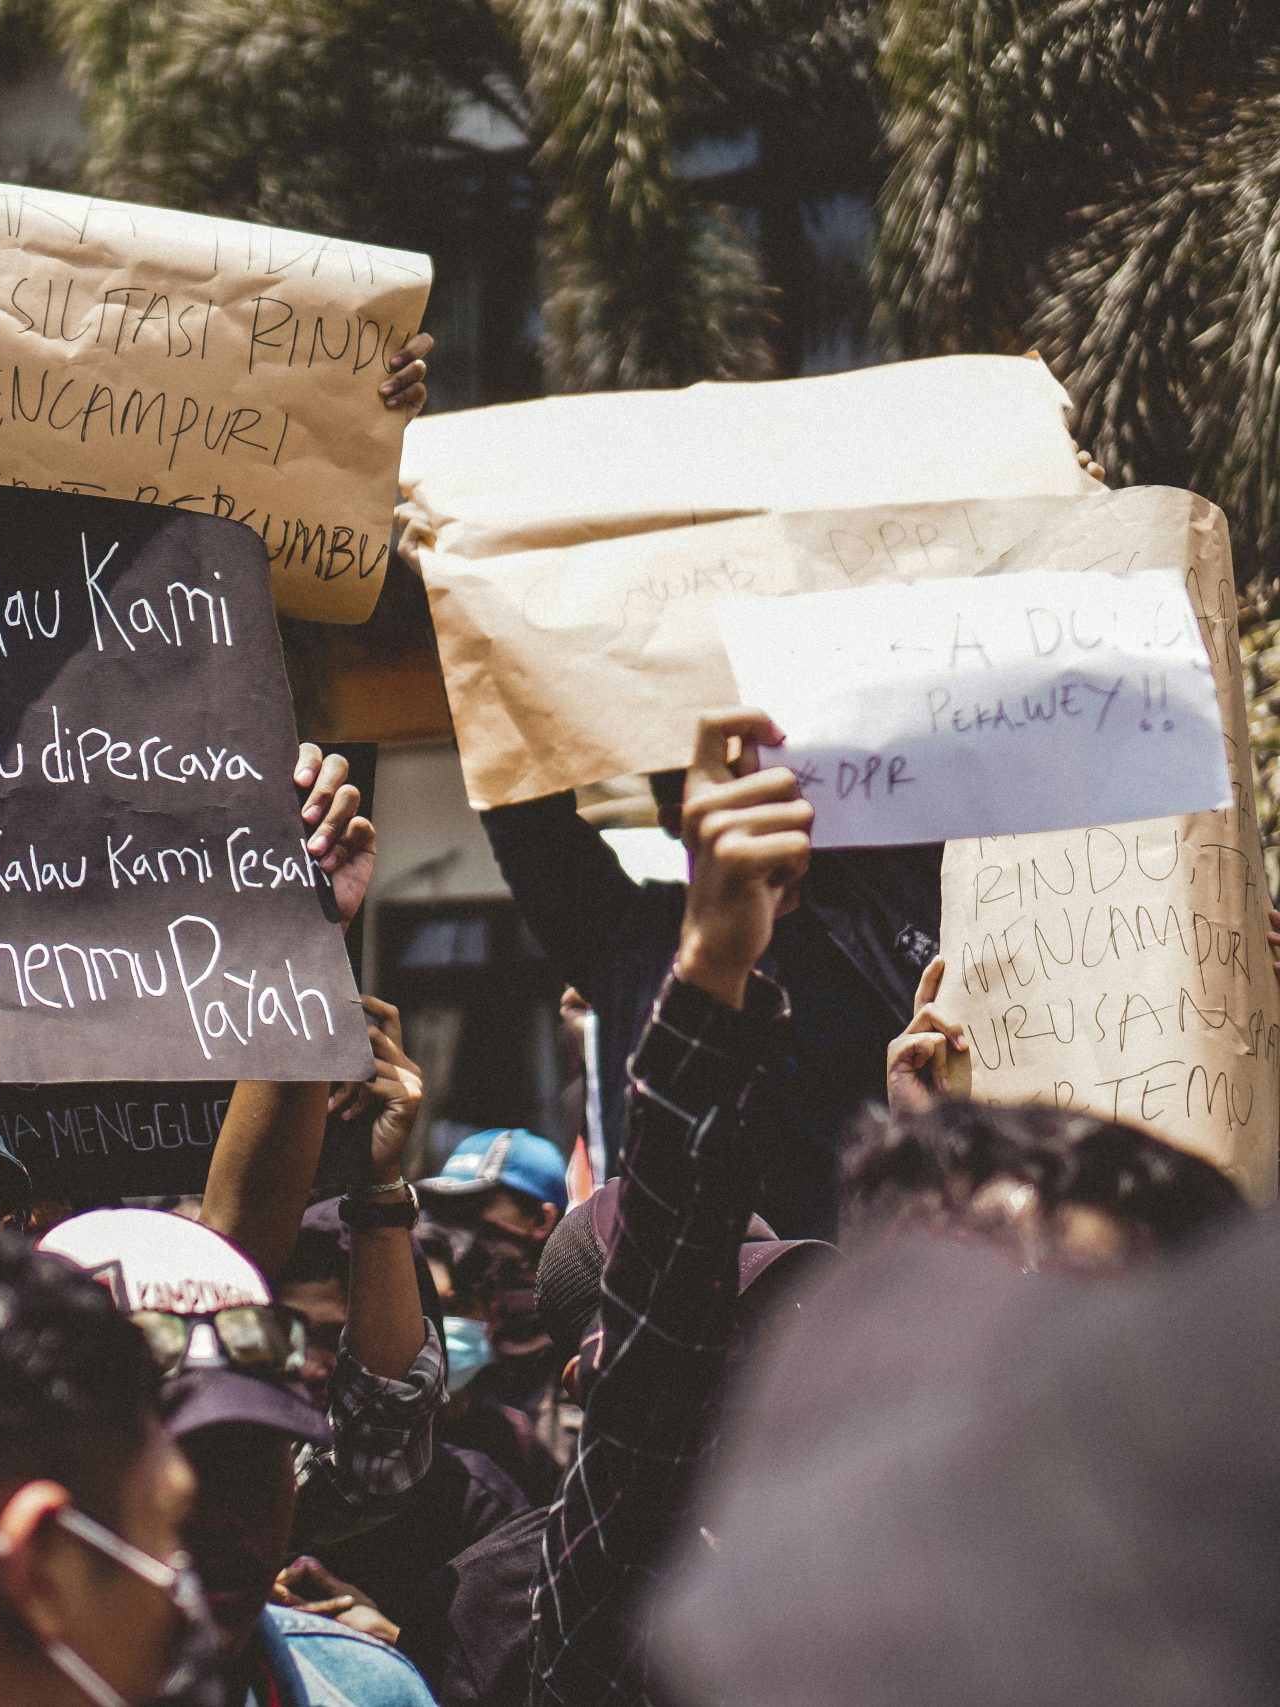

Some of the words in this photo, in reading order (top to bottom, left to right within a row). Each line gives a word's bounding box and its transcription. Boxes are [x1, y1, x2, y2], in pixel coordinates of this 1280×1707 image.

[80, 530, 233, 652] Kami
[106, 834, 213, 890] Kami
[960, 904, 1252, 999] MENCAMPURI
[967, 987, 1228, 1072] URUSAN
